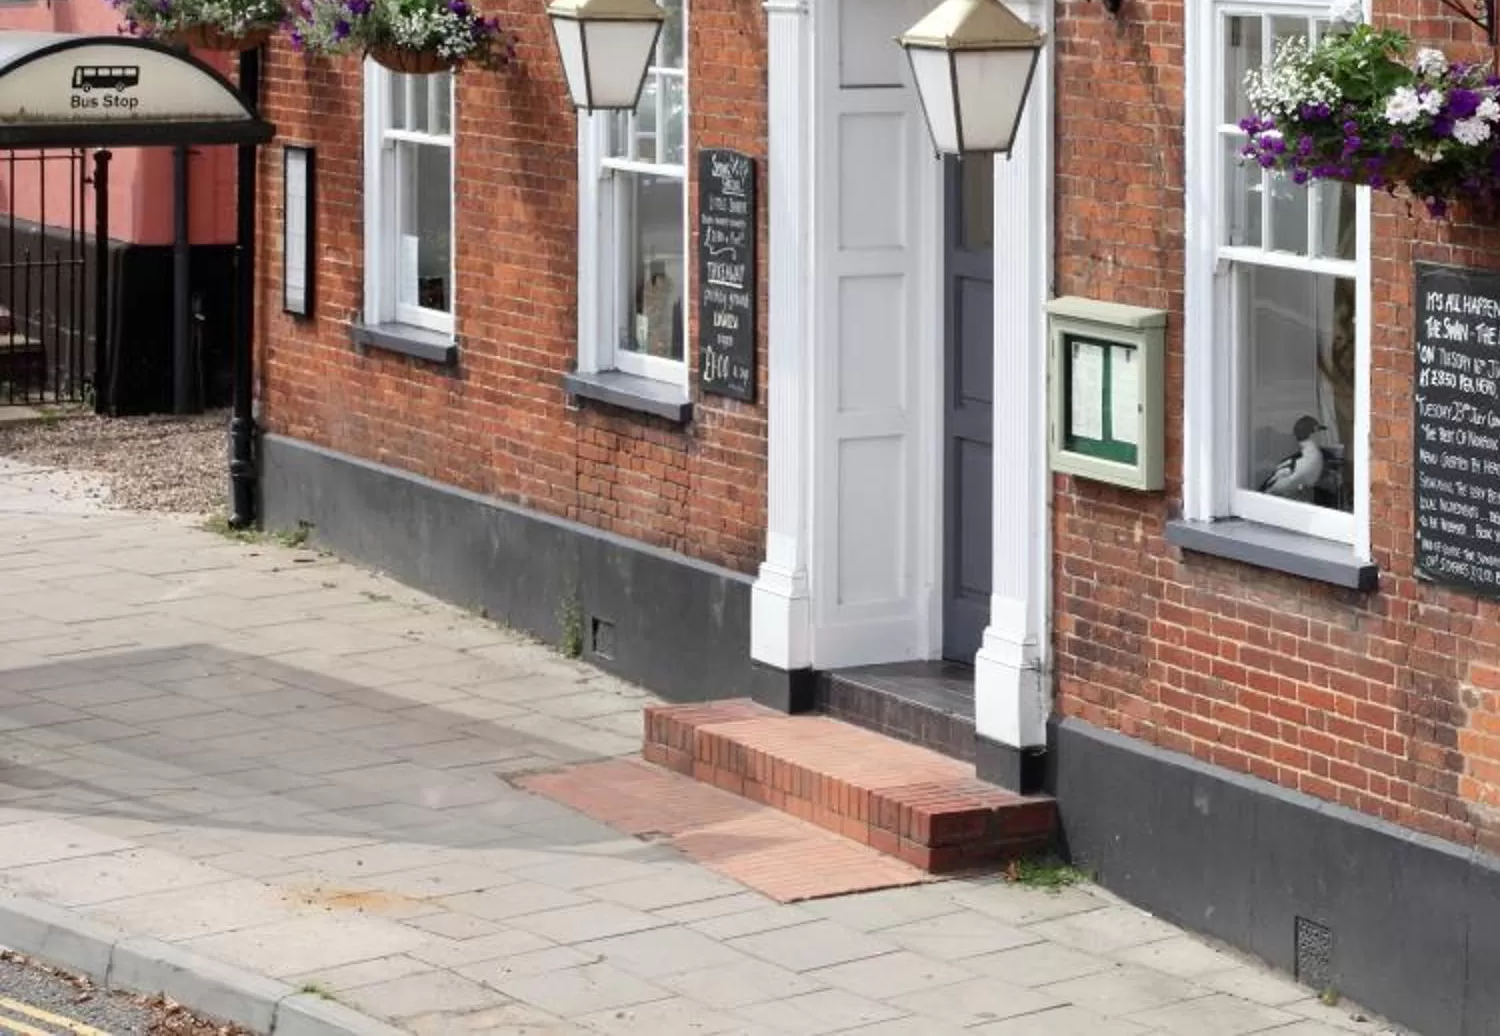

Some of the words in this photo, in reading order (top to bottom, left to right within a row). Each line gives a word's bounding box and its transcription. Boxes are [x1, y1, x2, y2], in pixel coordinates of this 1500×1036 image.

[70, 94, 98, 109] Bus
[103, 94, 139, 111] Stop
[1475, 323, 1497, 345] THE
